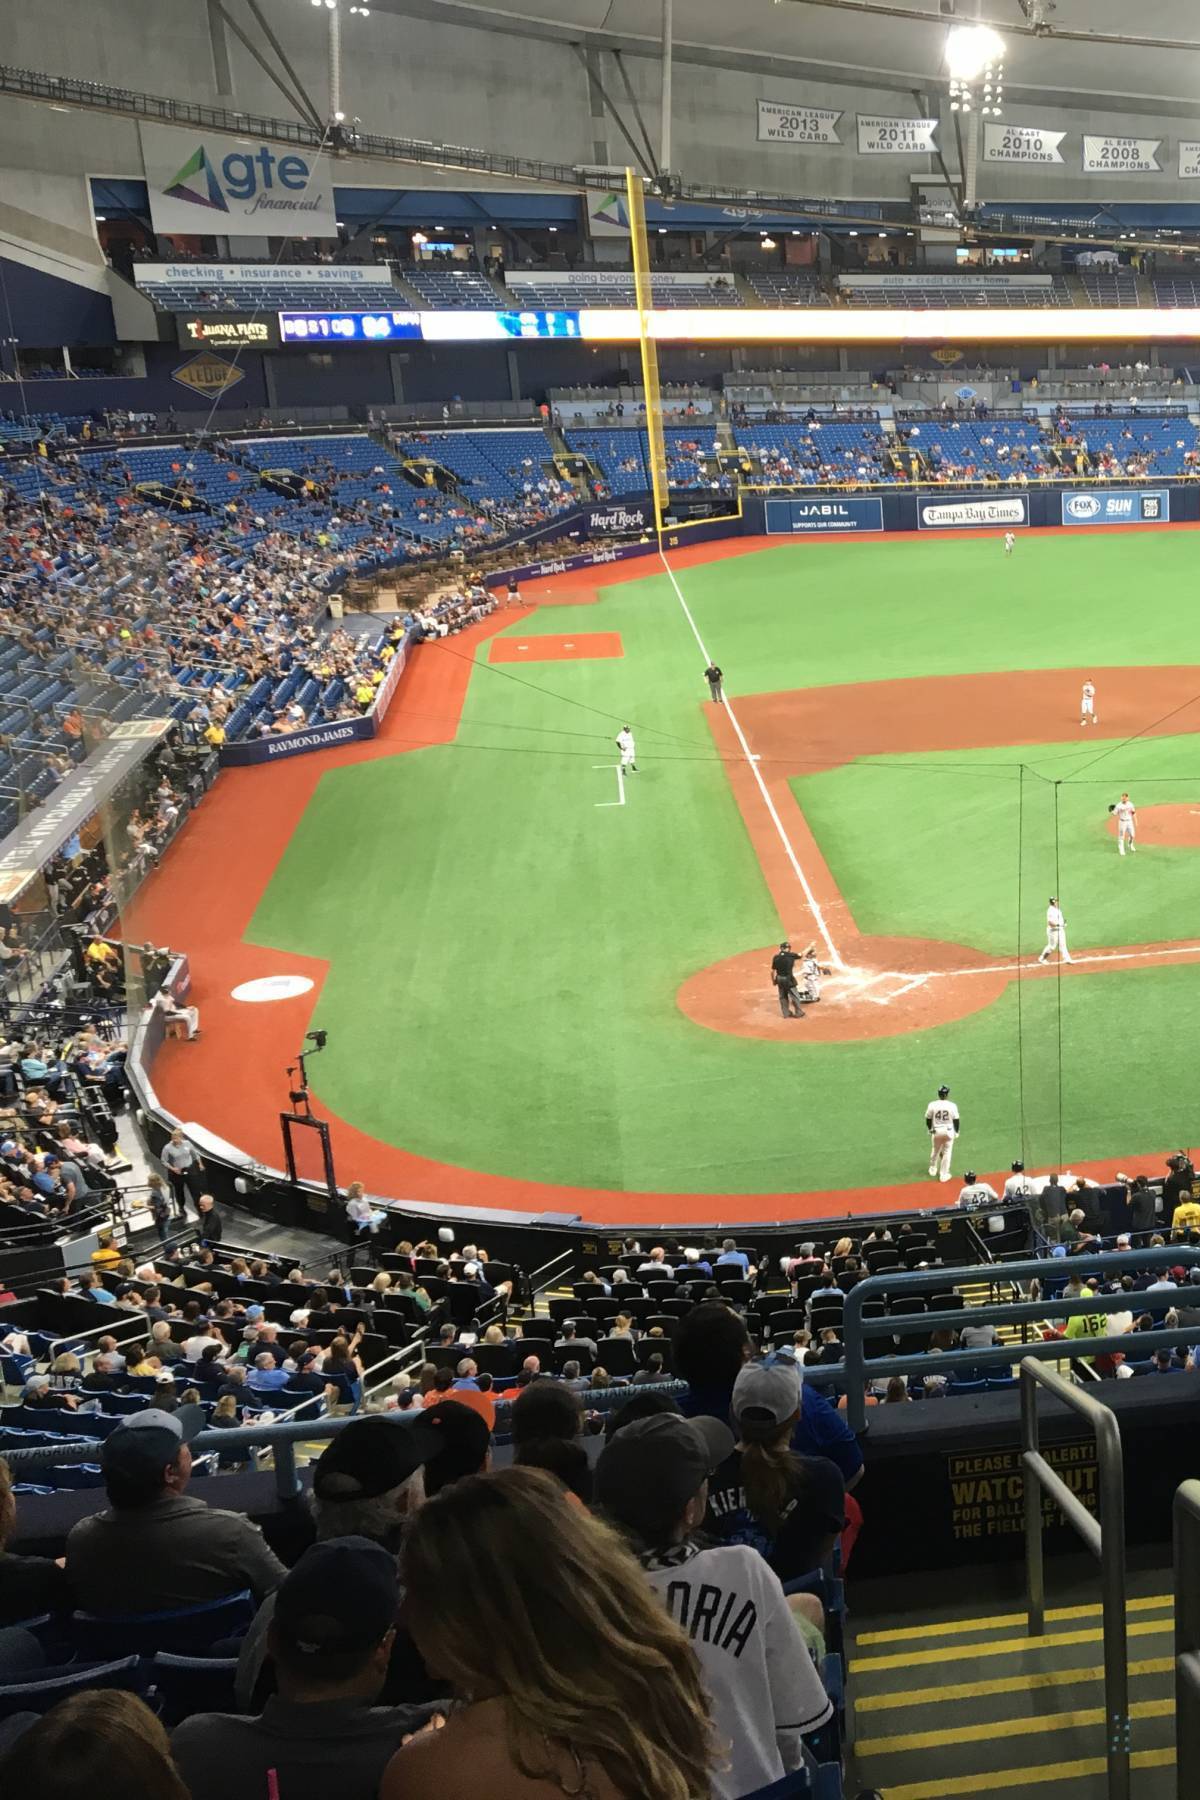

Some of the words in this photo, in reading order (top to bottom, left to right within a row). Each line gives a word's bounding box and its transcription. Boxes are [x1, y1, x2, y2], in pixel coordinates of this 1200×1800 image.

[761, 106, 802, 118] AMERICAN
[805, 110, 835, 120] LEAGUE
[779, 116, 819, 131] 2013
[860, 120, 899, 128] AMERICAN
[902, 121, 931, 129] LEAGUE
[768, 129, 794, 138] WILD
[799, 132, 828, 141] CARD
[879, 128, 915, 141] 2011
[867, 142, 893, 150] WILD
[898, 142, 925, 150] CARD
[1002, 137, 1042, 151] 2010
[990, 150, 1053, 161] CHAMPIONS
[1100, 148, 1139, 160] 2008
[1089, 161, 1150, 169] CHAMPIONS
[222, 147, 310, 199] gte
[244, 195, 321, 215] financial
[166, 267, 224, 281] checking
[240, 267, 301, 279] insurance
[318, 269, 363, 281] savings
[568, 273, 597, 284] going
[916, 275, 945, 284] credit
[947, 275, 977, 284] cards
[237, 323, 268, 336] FLATS
[800, 505, 848, 516] JABIL
[1074, 501, 1092, 510] FOX
[1106, 499, 1132, 513] SUN
[590, 511, 617, 528] Hard
[618, 509, 644, 526] Rock
[928, 509, 963, 523] Tampa
[965, 507, 986, 520] Bay
[988, 505, 1019, 518] Times
[268, 734, 320, 754] RAYMOND
[320, 726, 354, 742] JAMES
[935, 1110, 949, 1120] 42
[955, 1456, 1012, 1474] PLEASE
[952, 1476, 1024, 1505] WATC
[953, 1507, 981, 1522] FOR
[953, 1525, 981, 1538] THE
